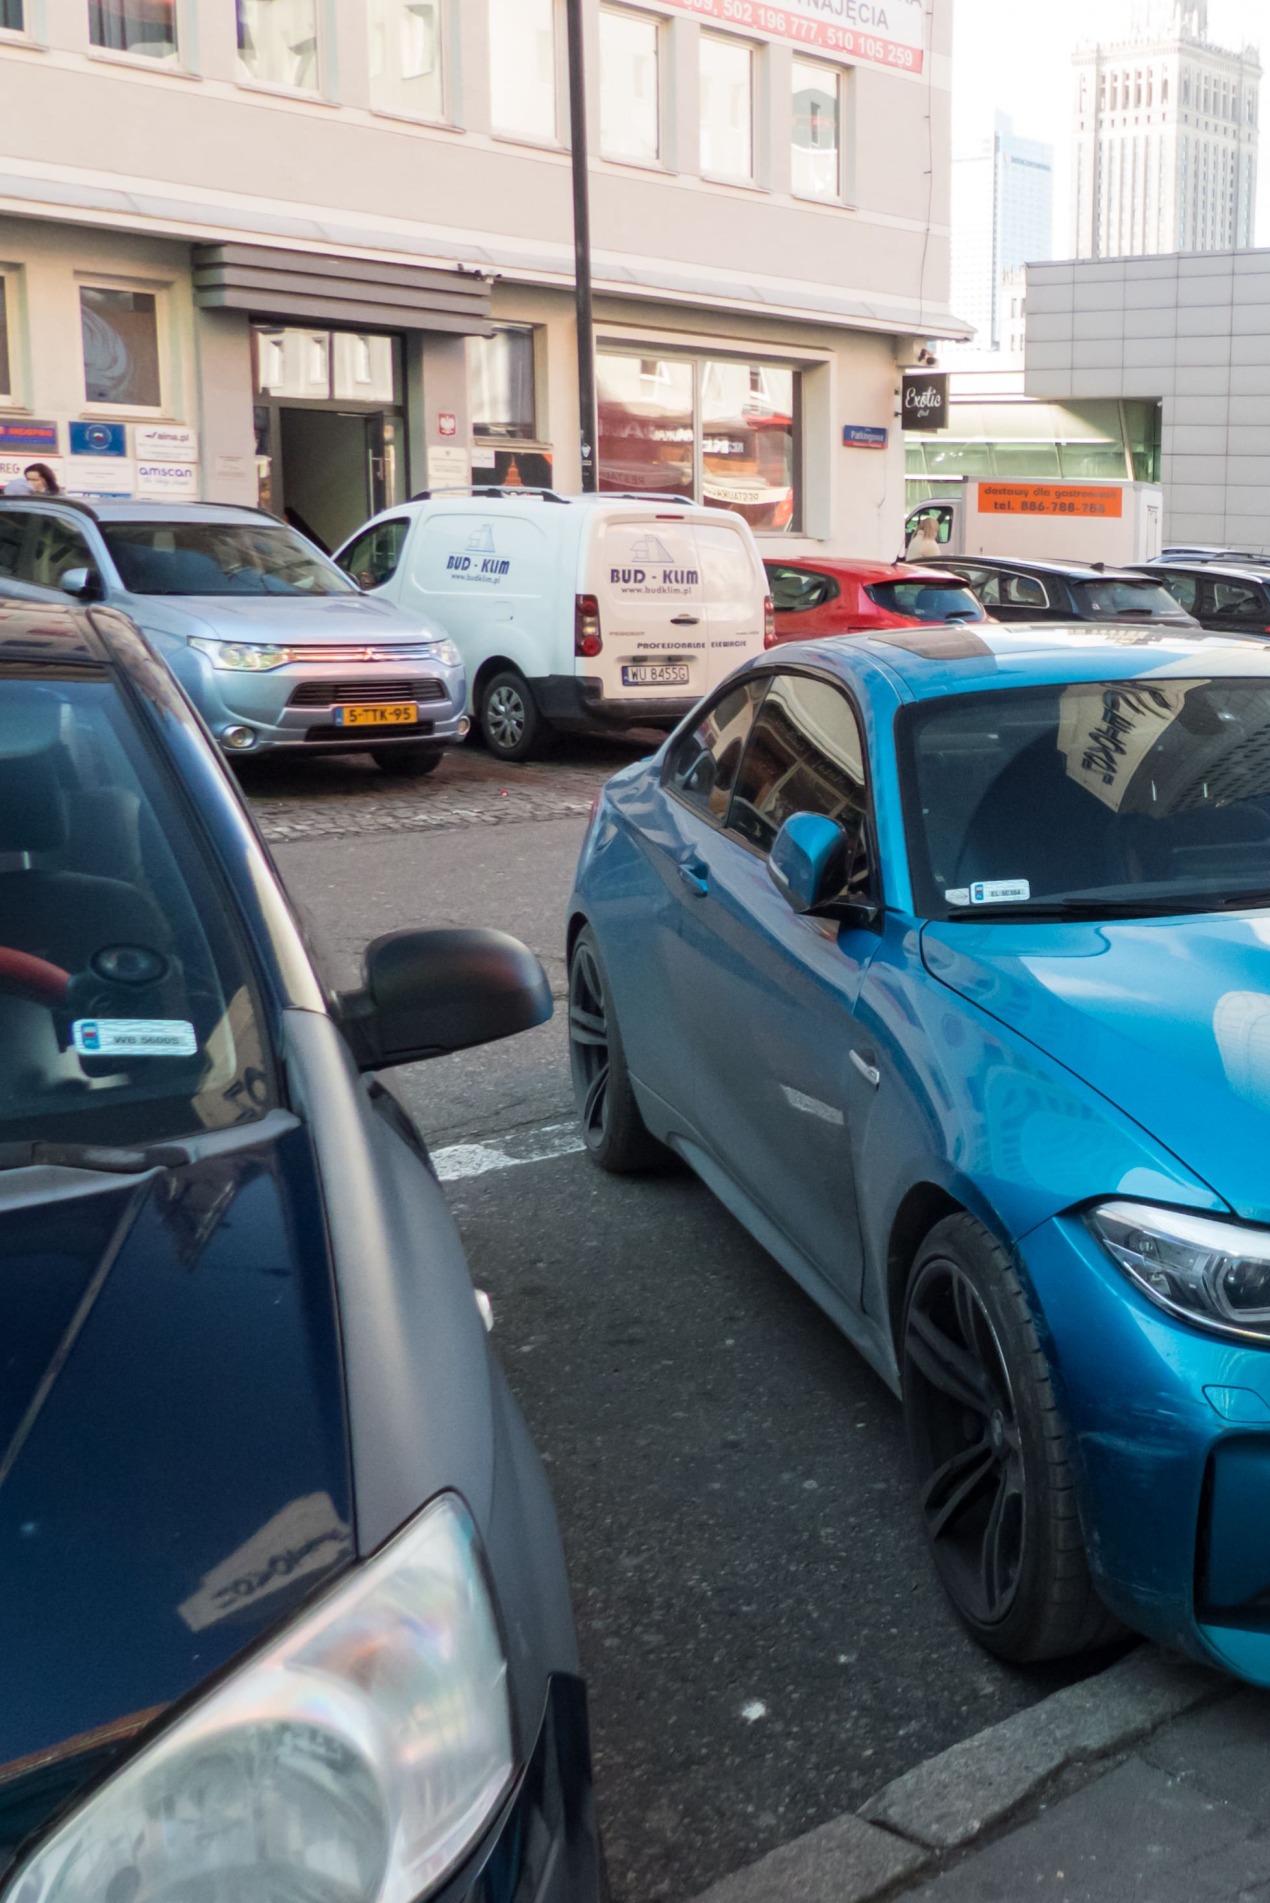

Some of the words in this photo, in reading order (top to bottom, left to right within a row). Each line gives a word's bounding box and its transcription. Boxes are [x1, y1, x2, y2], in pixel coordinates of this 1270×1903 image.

[723, 0, 752, 22] 502
[758, 9, 786, 31] 196
[790, 16, 822, 44] 777,
[827, 26, 853, 49] 510
[858, 36, 884, 59] 105
[888, 44, 913, 67] 259
[905, 386, 942, 408] Exotic
[139, 466, 193, 478] amscan
[984, 486, 1029, 498] dostawy
[1033, 487, 1051, 497] dla
[993, 500, 1015, 511] tel.
[446, 555, 471, 571] BUD
[481, 558, 510, 575] KLIM
[451, 572, 501, 585] www.budklim.pl
[610, 568, 646, 584] BUD
[663, 568, 699, 585] KLIM
[621, 585, 692, 596] www.budklim.pl
[630, 667, 647, 681] WU
[651, 667, 686, 681] 8455G
[349, 707, 411, 723] 5-TTK-95
[114, 1036, 136, 1044] WB
